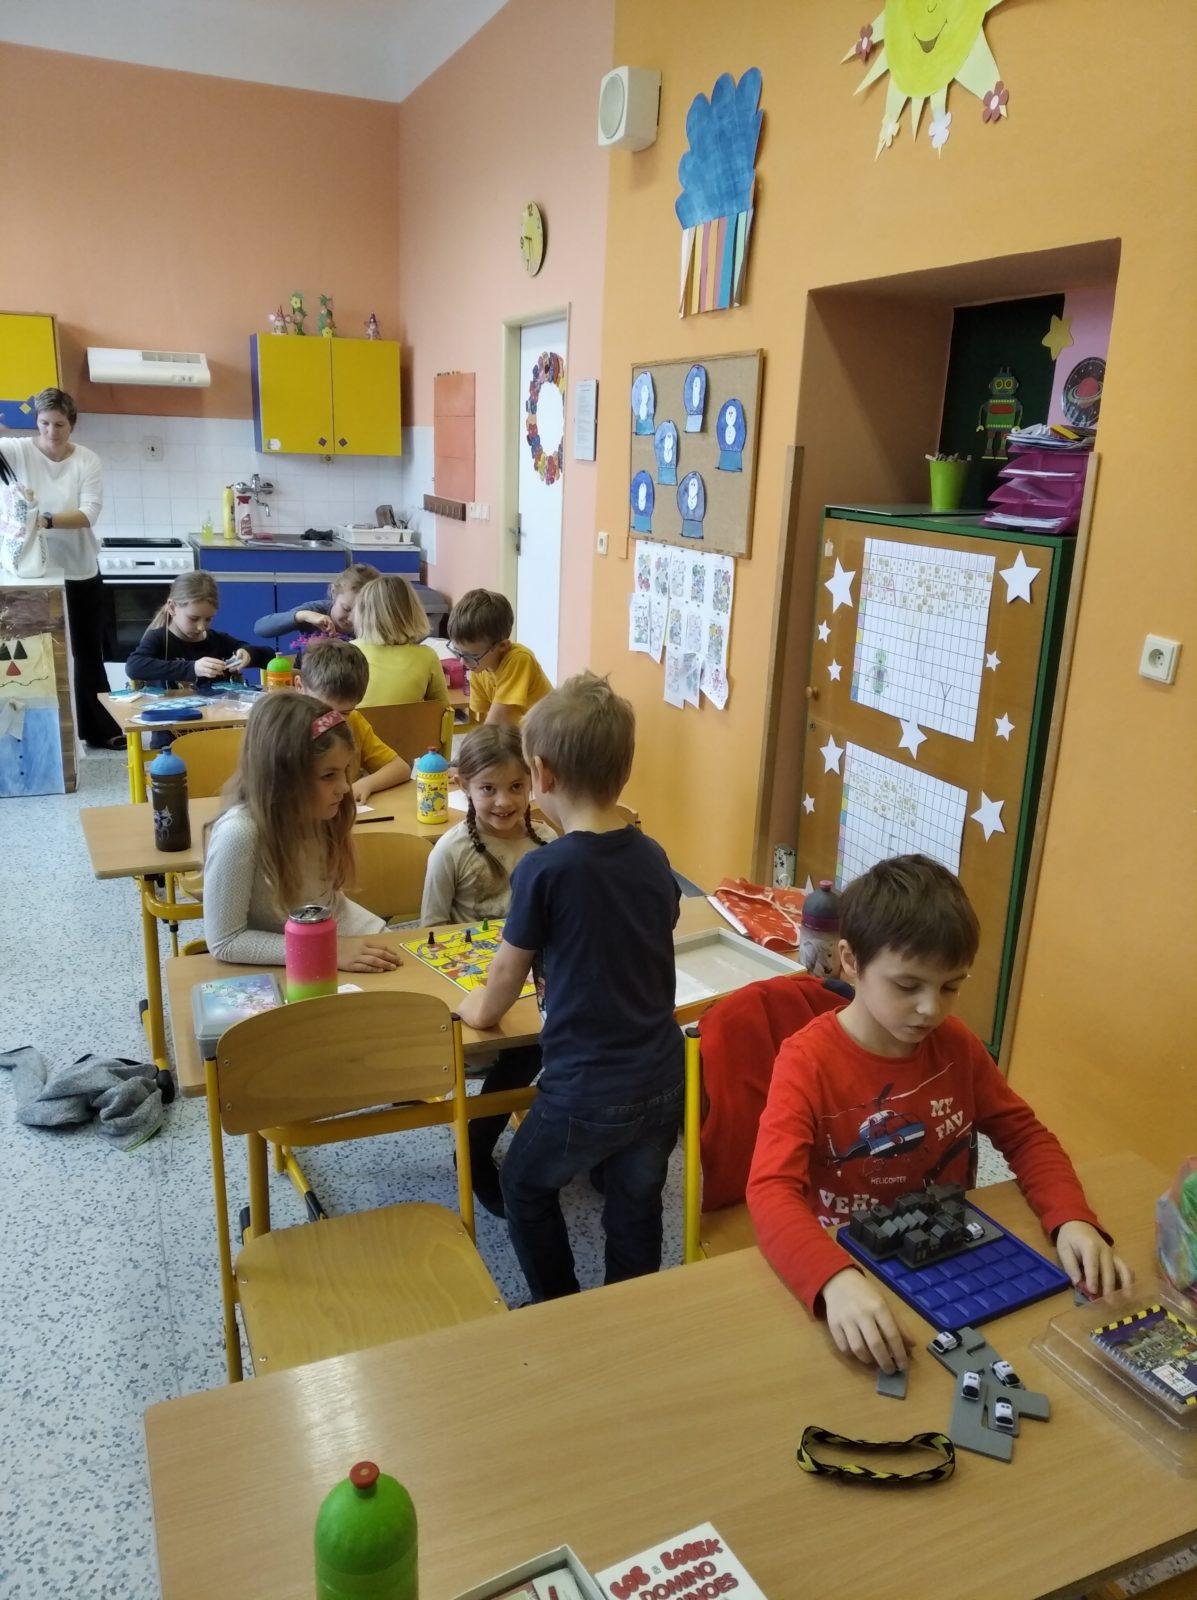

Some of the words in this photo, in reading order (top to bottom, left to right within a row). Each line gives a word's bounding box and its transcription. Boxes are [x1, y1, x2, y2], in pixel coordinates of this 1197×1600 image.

[930, 1097, 953, 1117] MY
[935, 1110, 964, 1141] FAV
[870, 1175, 907, 1185] HELICOPTER
[638, 1560, 717, 1600] DOMINO
